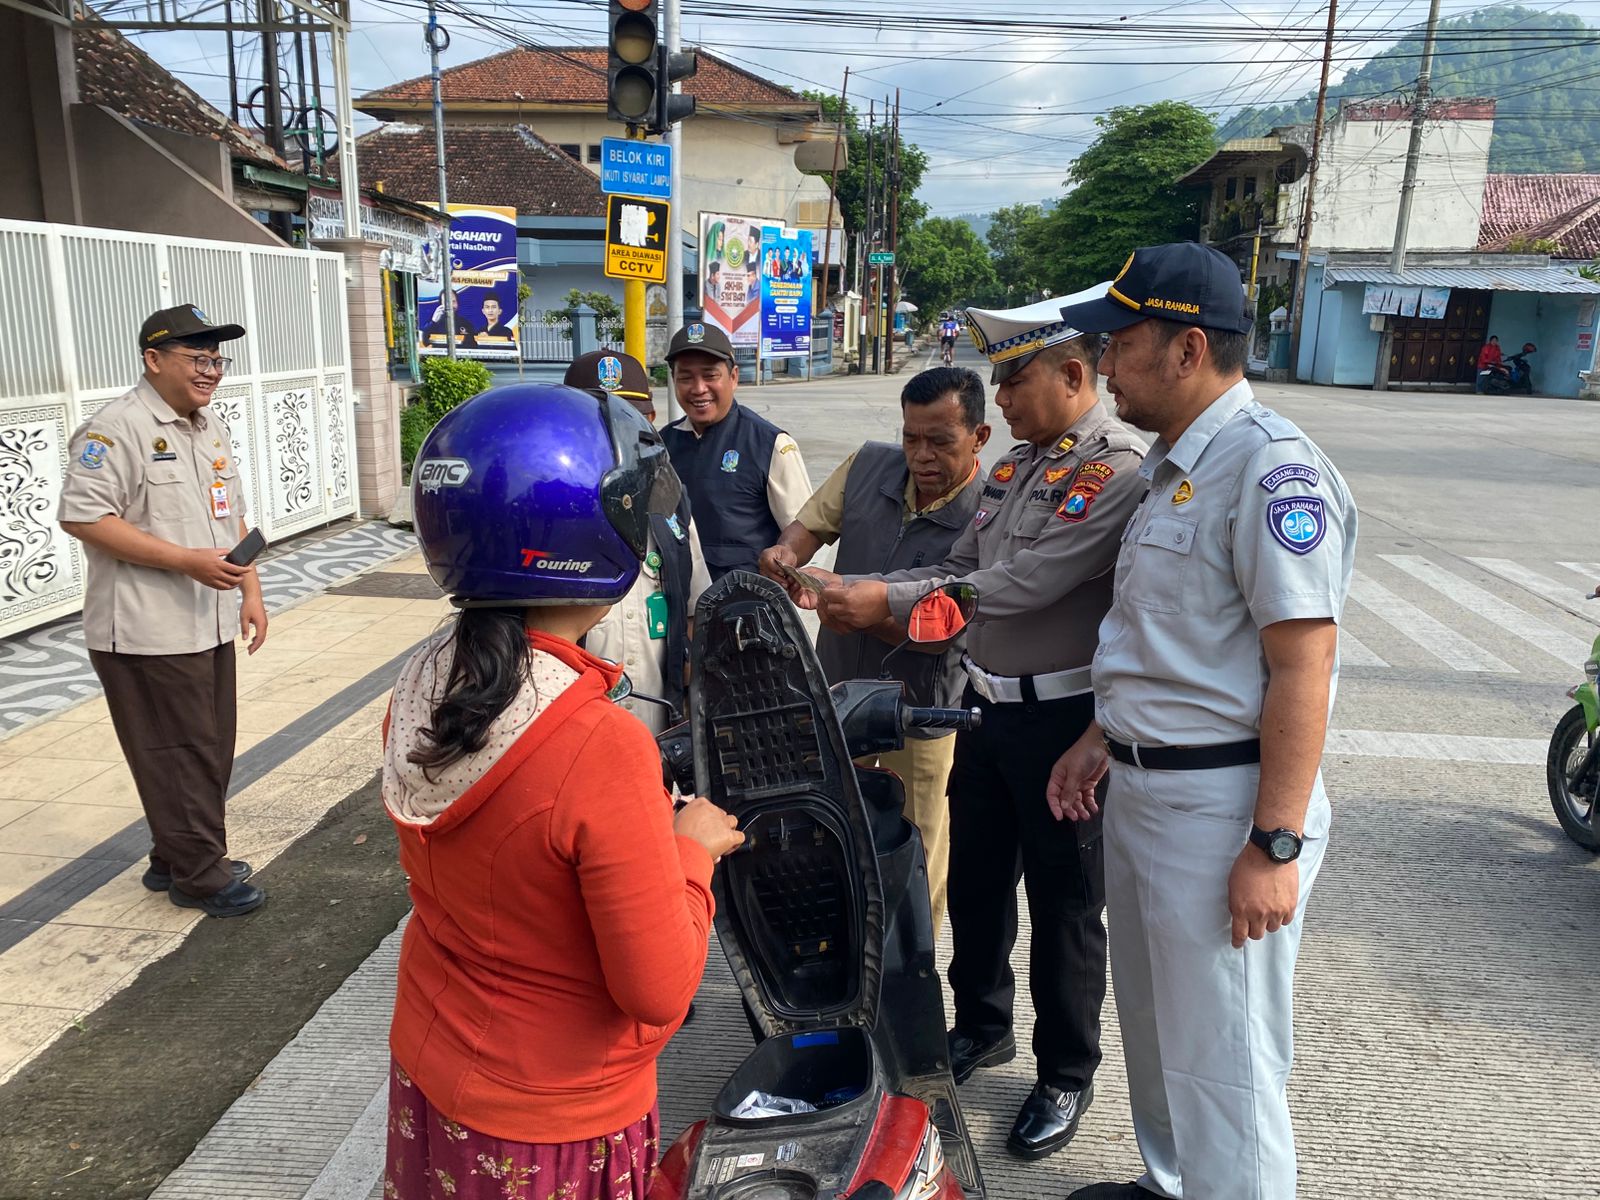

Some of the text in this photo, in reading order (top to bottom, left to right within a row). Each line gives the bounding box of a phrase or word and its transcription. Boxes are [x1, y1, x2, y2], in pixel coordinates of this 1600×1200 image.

[609, 149, 665, 167] BELOK KIRI
[604, 169, 670, 187] IKUTI ISYARAT LAMPU
[463, 243, 496, 251] NasDem
[611, 248, 662, 261] AREA DIAWASI
[619, 260, 654, 273] CCTV
[1144, 297, 1200, 315] JASA RAHARJA
[420, 463, 465, 482] BMC
[1079, 463, 1112, 476] POLRES
[1266, 468, 1316, 486] CABANG JATIM
[1273, 502, 1320, 514] JASA RAHARJA
[521, 548, 593, 573] Touring
